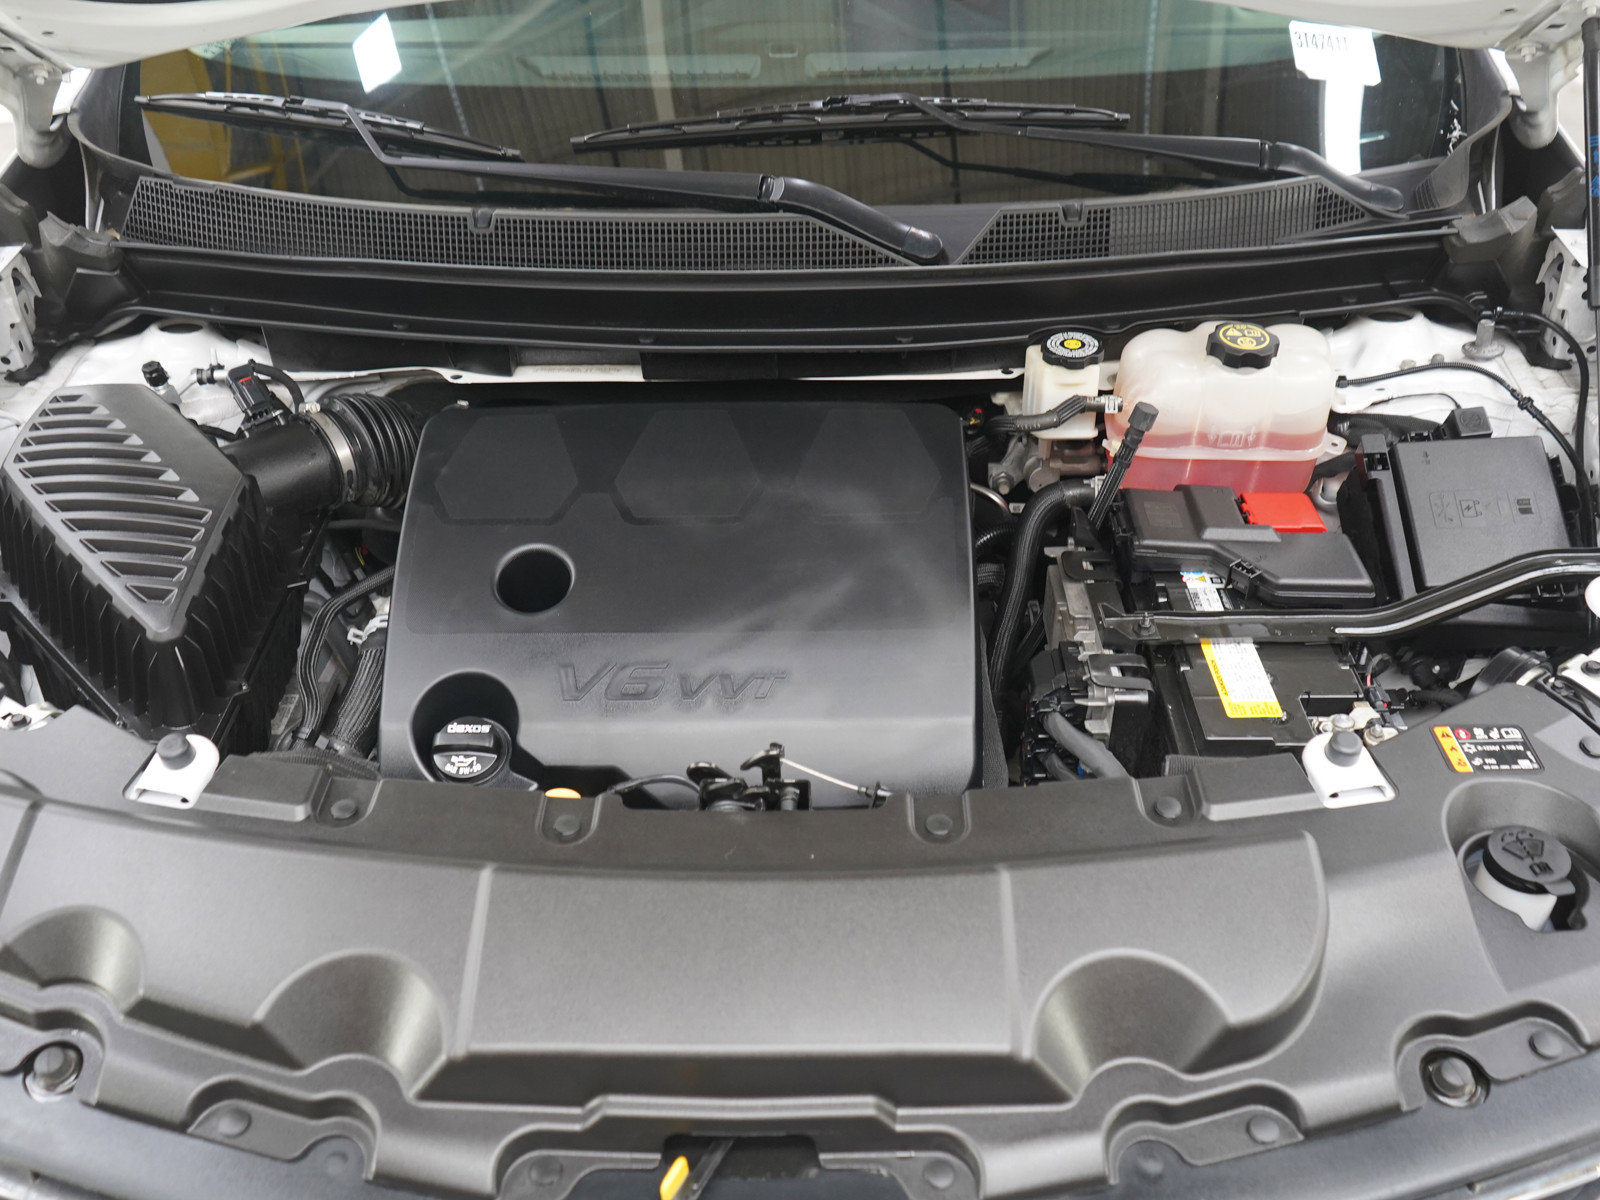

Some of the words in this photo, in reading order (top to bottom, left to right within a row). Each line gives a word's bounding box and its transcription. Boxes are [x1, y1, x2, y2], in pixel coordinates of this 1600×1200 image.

[558, 661, 670, 701] V6
[679, 672, 787, 700] VVT
[447, 722, 492, 733] dexos
